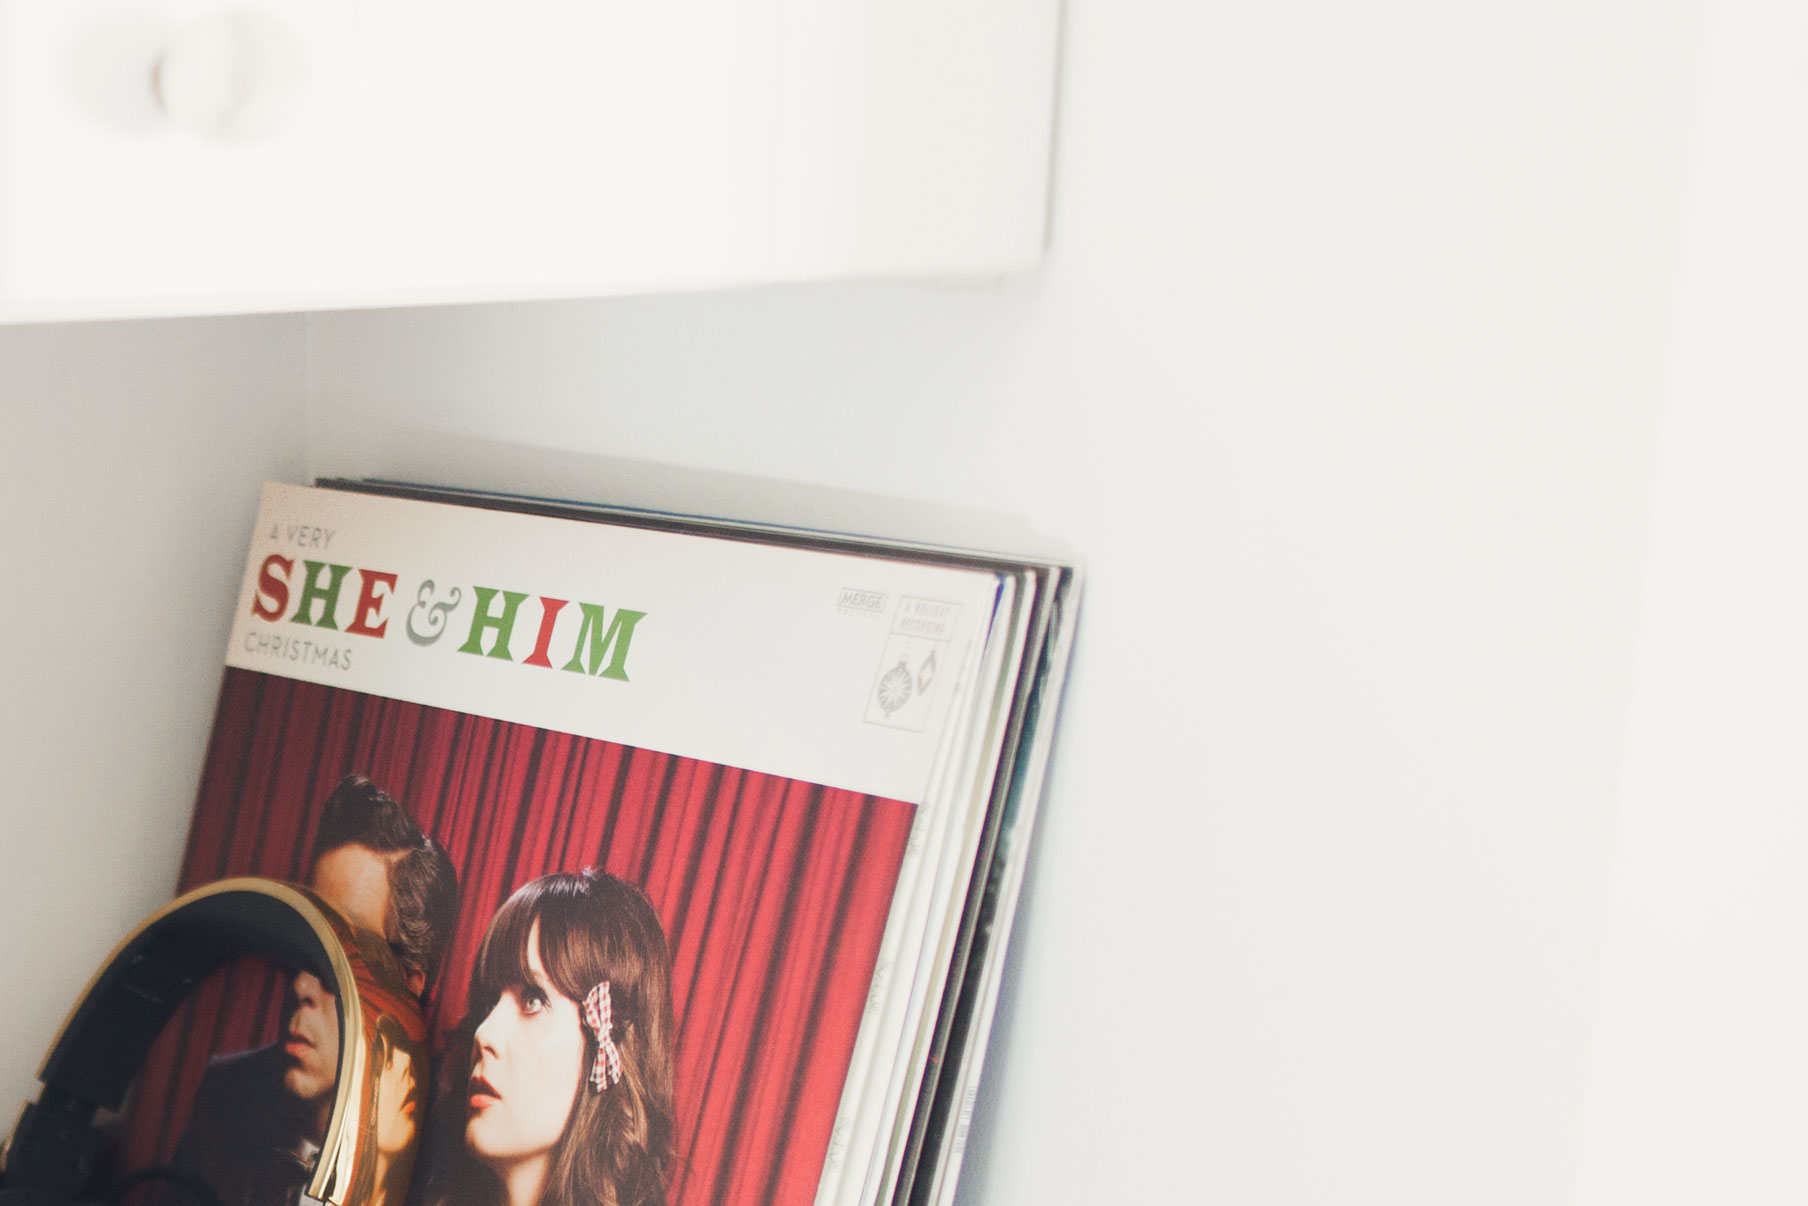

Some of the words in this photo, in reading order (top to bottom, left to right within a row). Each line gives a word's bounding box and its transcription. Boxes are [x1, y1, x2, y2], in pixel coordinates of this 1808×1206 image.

[288, 523, 337, 552] VERY
[250, 553, 399, 639] SHE
[405, 578, 462, 648] &
[457, 585, 649, 682] HIM
[840, 591, 884, 609] MERGE
[243, 630, 354, 672] CHRISTMAS
